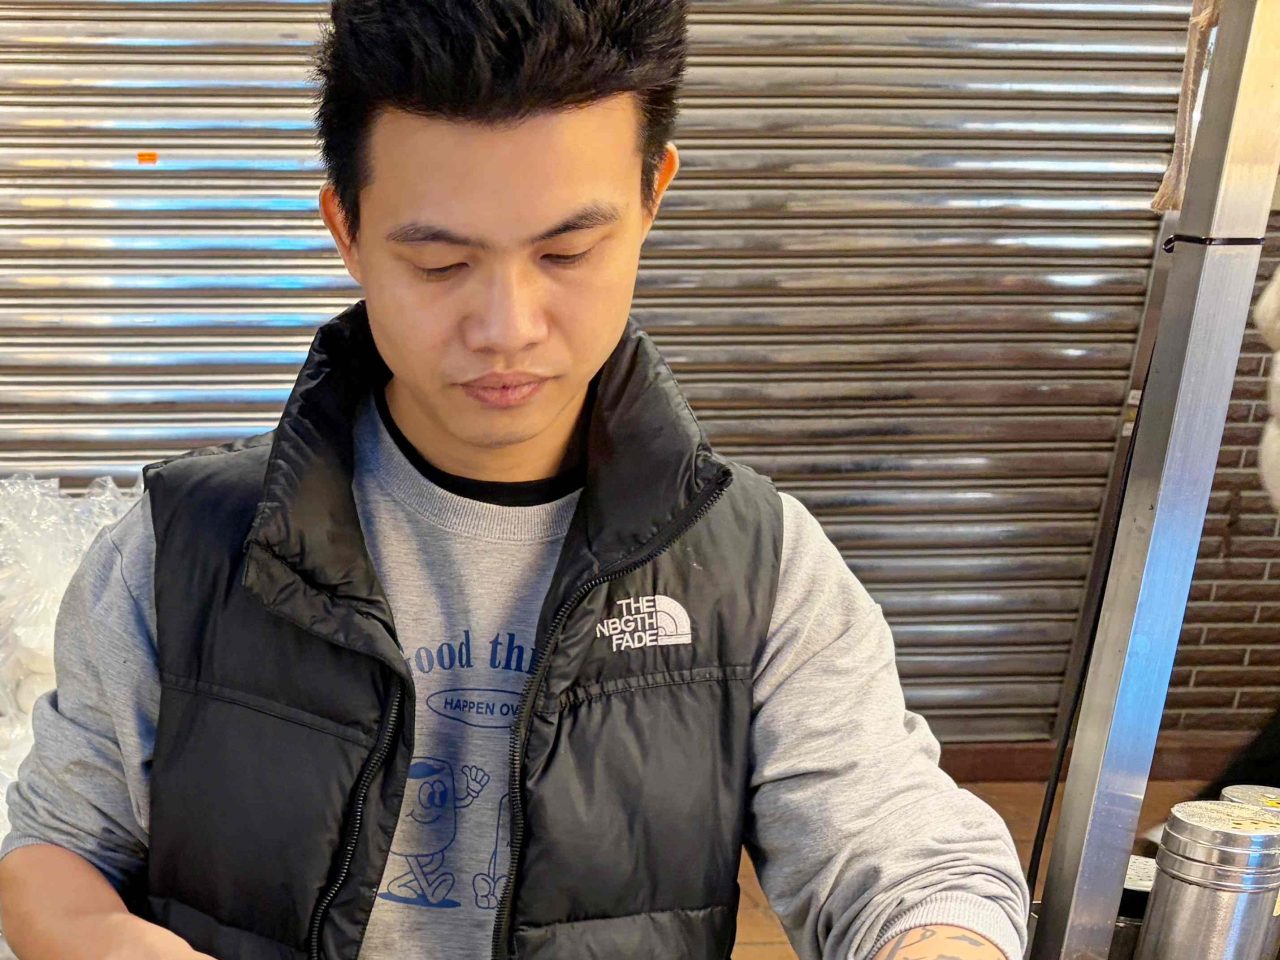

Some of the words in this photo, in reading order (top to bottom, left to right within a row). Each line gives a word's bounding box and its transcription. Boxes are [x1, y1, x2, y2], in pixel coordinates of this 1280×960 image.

[616, 596, 656, 617] THE
[596, 611, 658, 638] NBGTH
[405, 630, 473, 674] ood
[612, 630, 658, 652] FADE
[443, 698, 495, 715] HAPPEN
